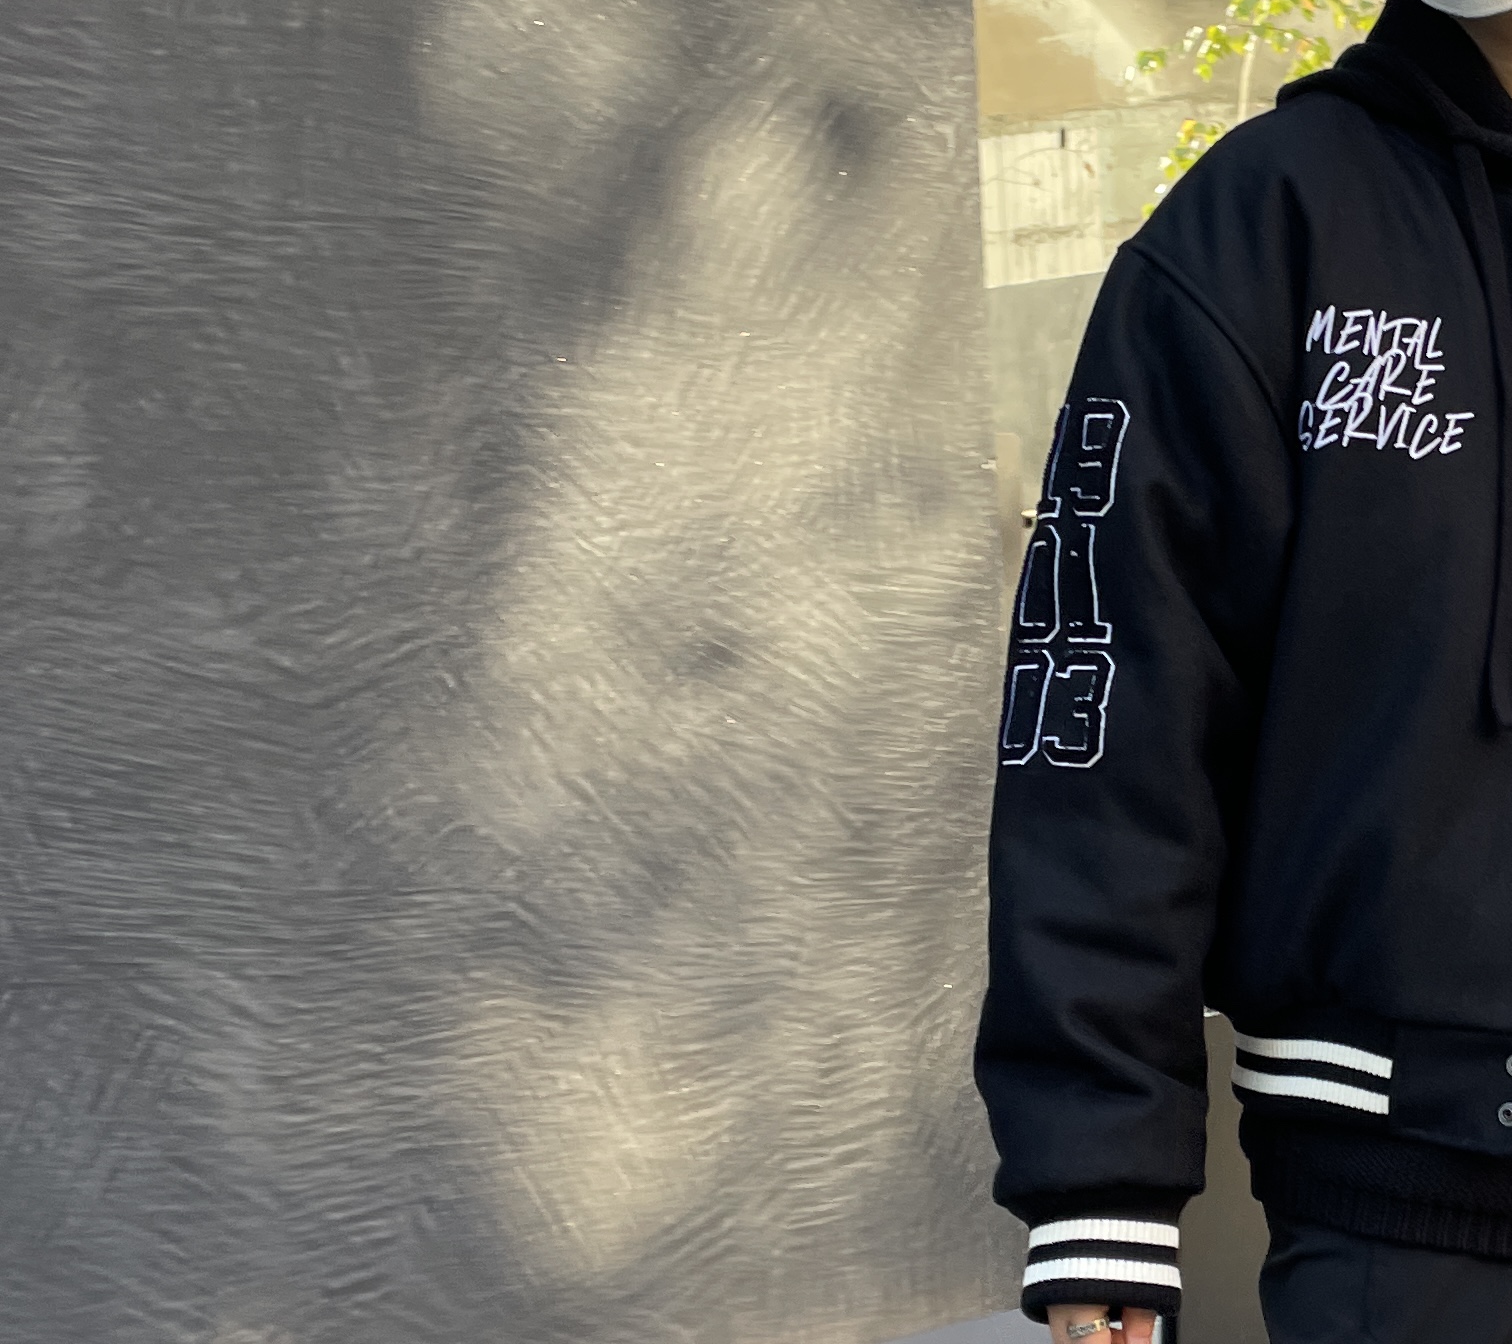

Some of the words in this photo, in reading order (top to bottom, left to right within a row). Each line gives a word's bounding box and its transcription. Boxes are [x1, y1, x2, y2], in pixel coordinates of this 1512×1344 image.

[1305, 305, 1444, 360] MENTAL
[1315, 349, 1446, 412] CARE
[1298, 394, 1475, 459] SERVICE
